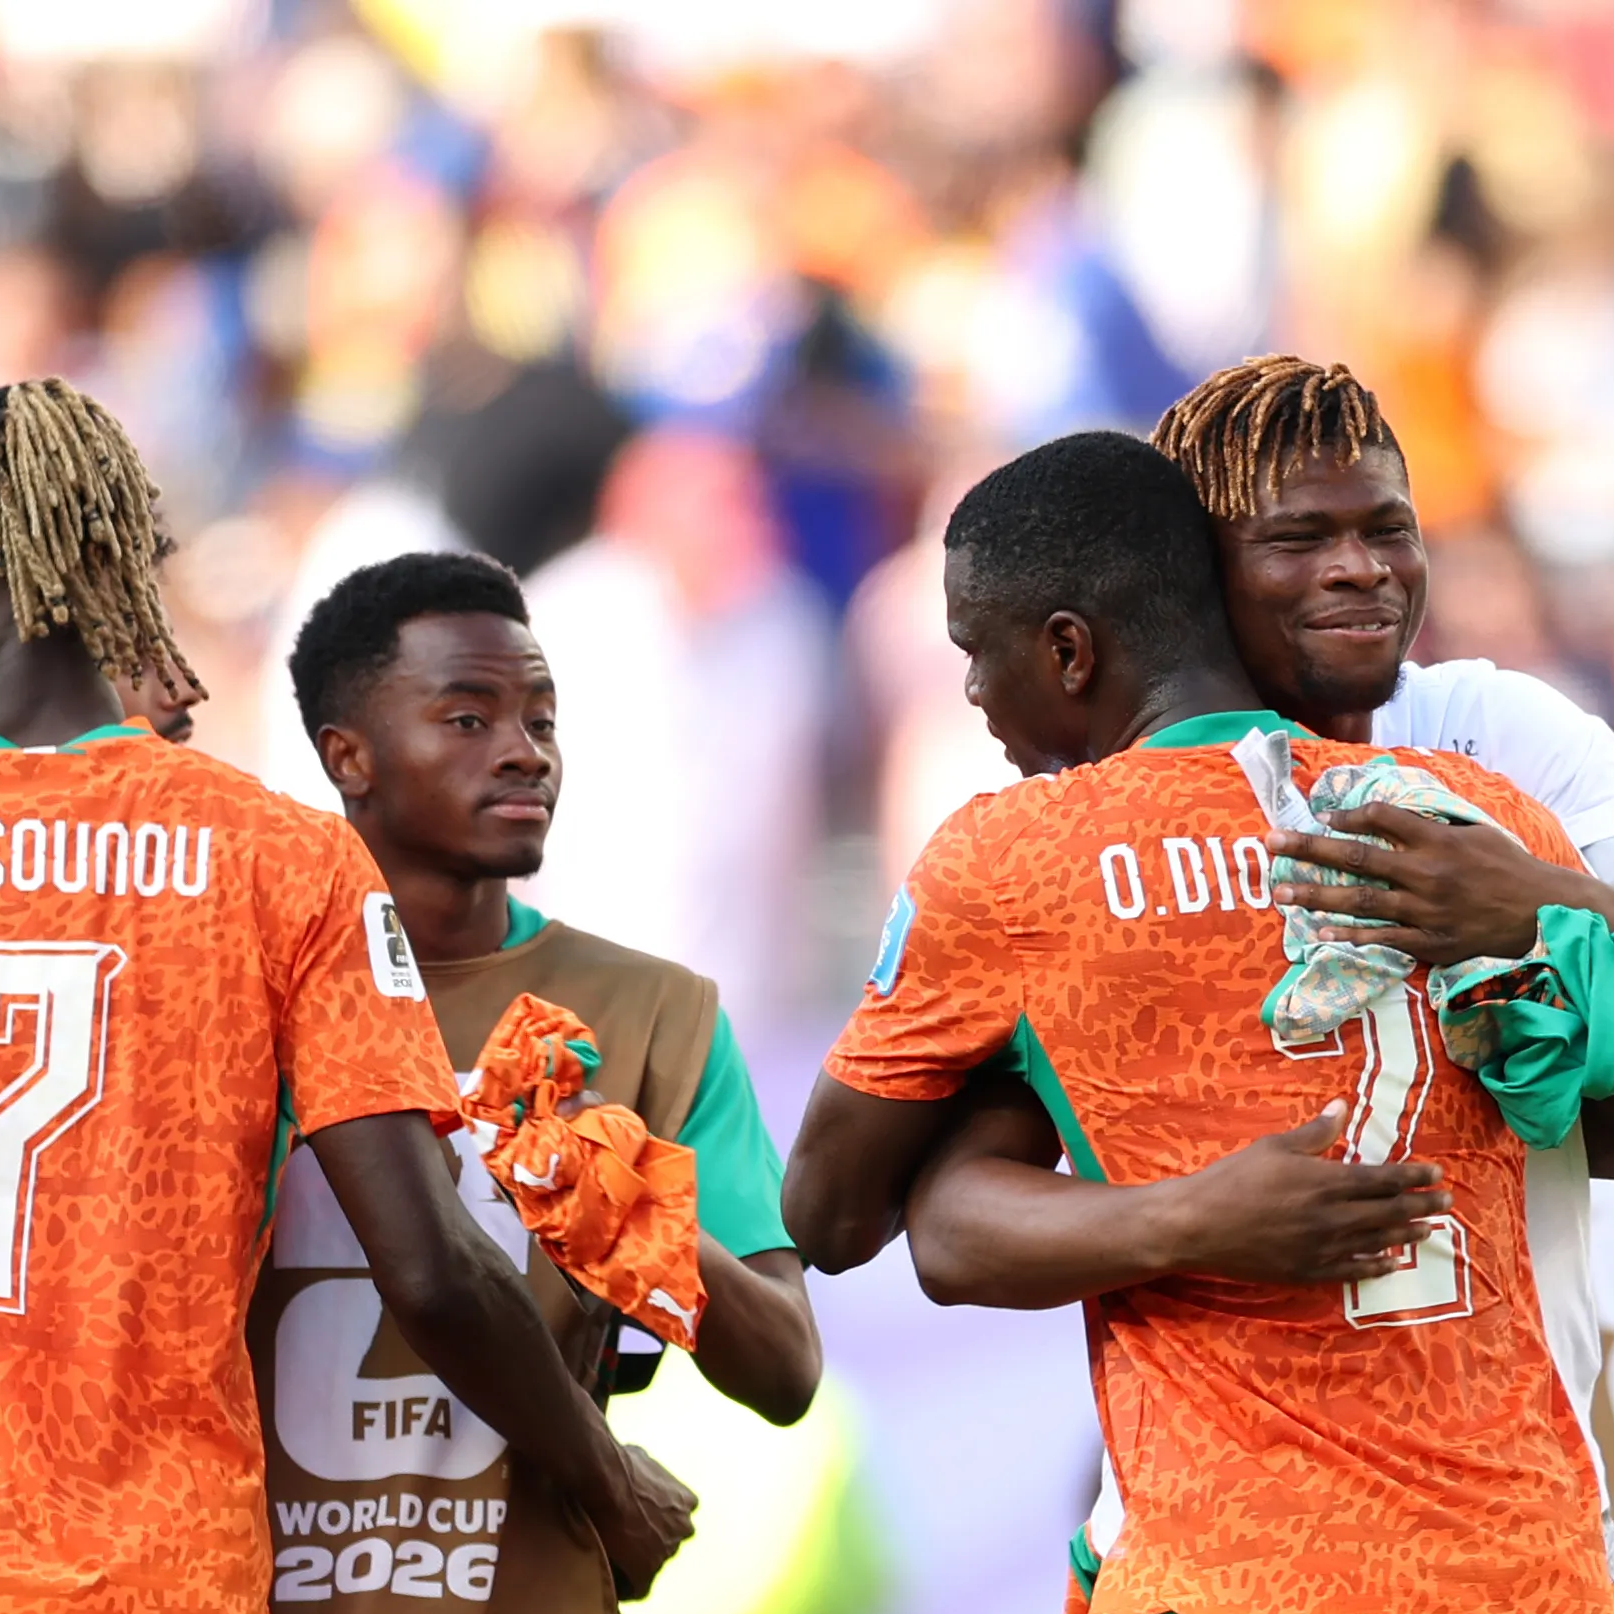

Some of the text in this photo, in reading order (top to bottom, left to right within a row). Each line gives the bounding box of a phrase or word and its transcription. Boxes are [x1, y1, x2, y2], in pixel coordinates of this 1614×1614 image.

[1099, 836, 1273, 920] O.DIO
[352, 1396, 452, 1442] FIFA
[275, 1492, 508, 1537] WORLD CUP
[274, 1537, 500, 1602] 2026
